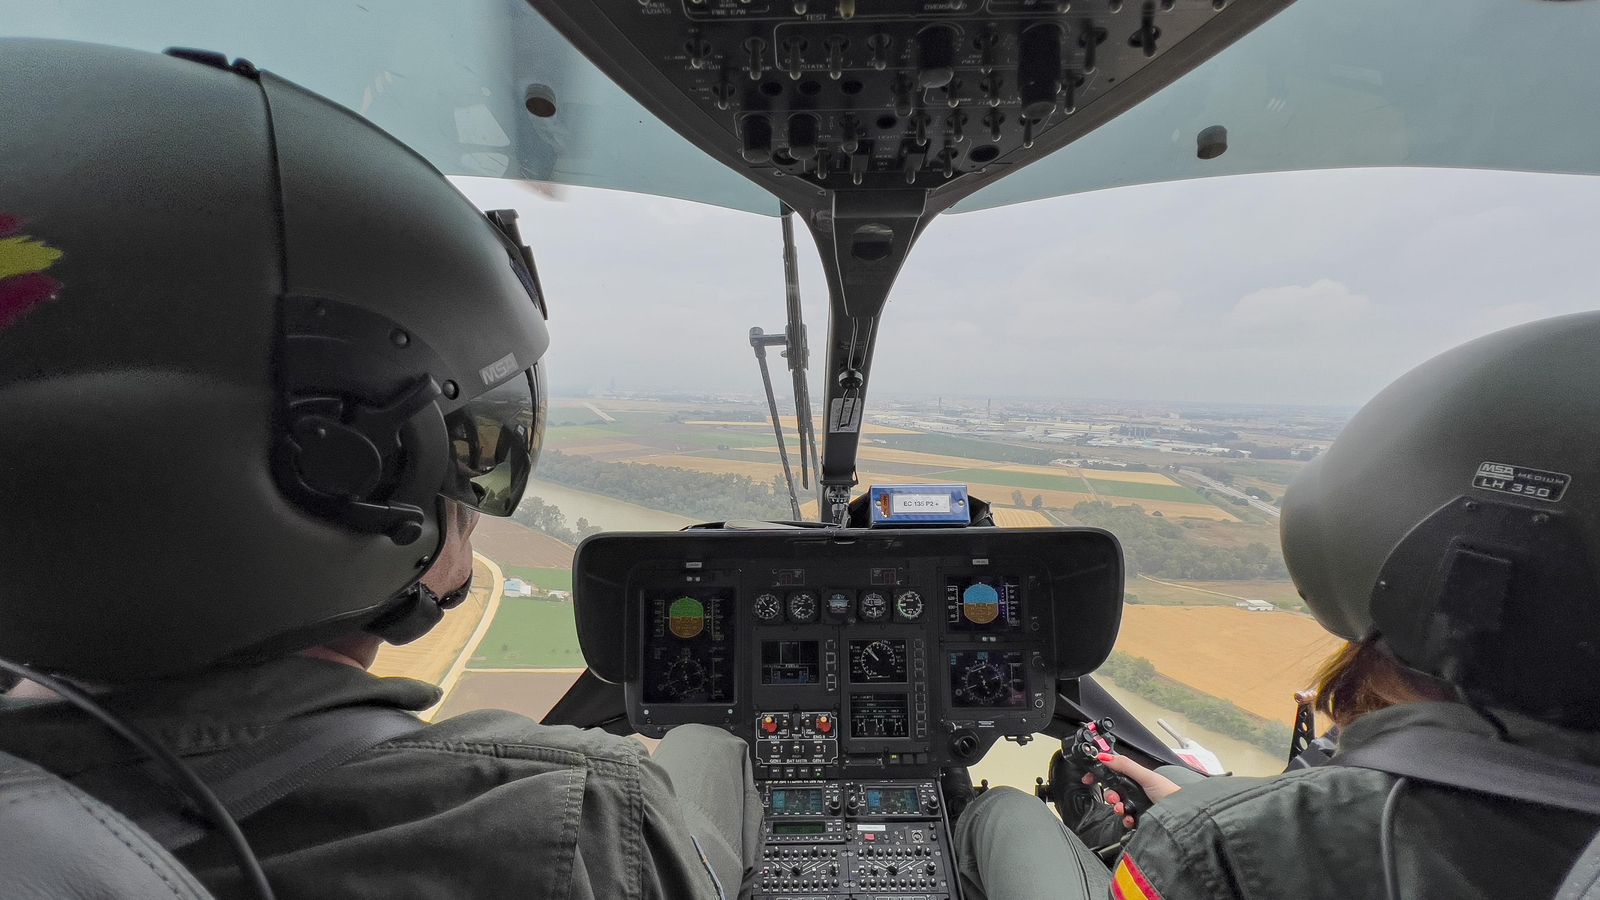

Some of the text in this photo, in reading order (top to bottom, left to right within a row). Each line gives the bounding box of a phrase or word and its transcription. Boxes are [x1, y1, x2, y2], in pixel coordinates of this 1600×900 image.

[805, 13, 827, 21] TEST
[1482, 463, 1565, 485] MSA MEDIUM
[1481, 478, 1551, 497] LH 350
